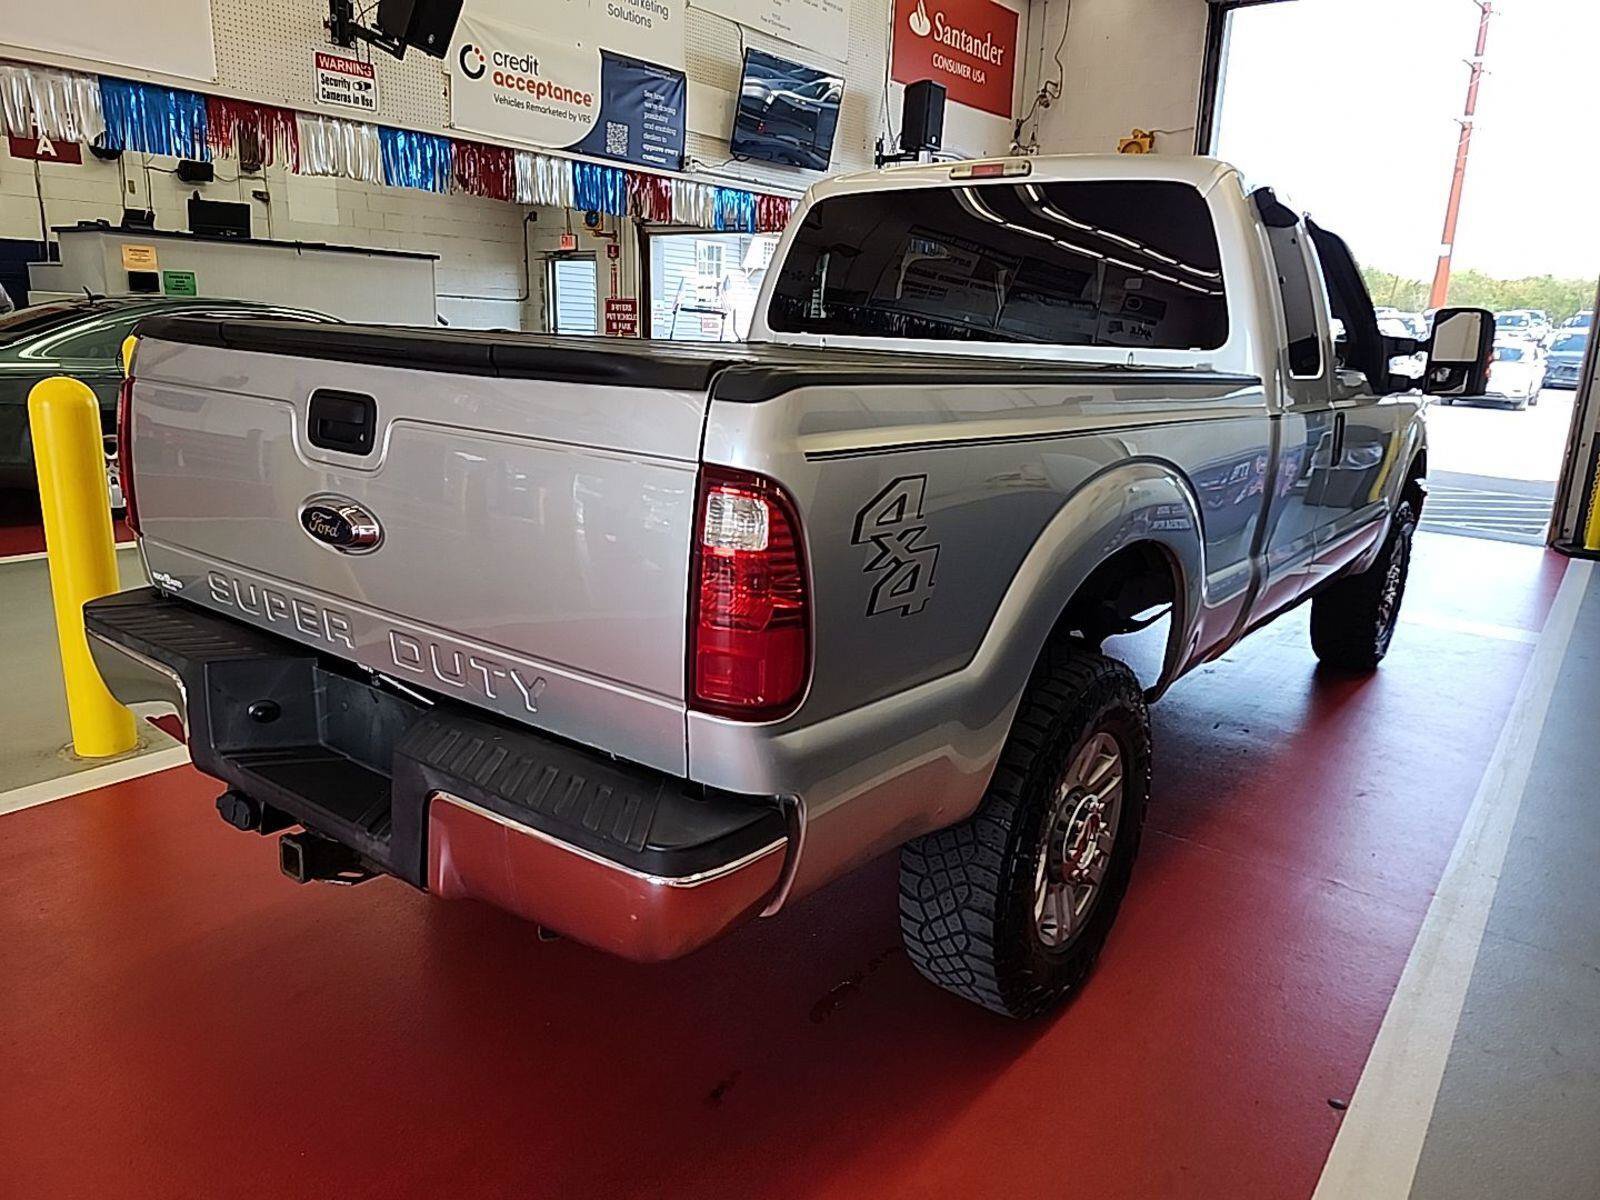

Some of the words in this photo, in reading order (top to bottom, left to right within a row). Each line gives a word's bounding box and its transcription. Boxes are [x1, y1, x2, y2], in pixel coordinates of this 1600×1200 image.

[607, 3, 652, 28] Solutions
[624, 0, 669, 20] arketing
[933, 12, 1003, 66] Santander
[318, 55, 372, 77] WARNING
[492, 51, 539, 76] credit
[932, 53, 971, 79] CONSUMER
[972, 68, 986, 84] USA
[320, 73, 351, 92] Security
[492, 71, 592, 107] acceptance
[321, 87, 352, 104] Cameras
[360, 94, 373, 108] Use
[493, 93, 525, 109] Vehicles
[525, 101, 568, 119] Remarketed
[568, 110, 577, 122] by
[577, 112, 592, 124] VRS
[36, 134, 58, 157] A
[308, 511, 341, 538] Ford
[206, 570, 356, 649] SUPER
[388, 630, 547, 713] DUTY
